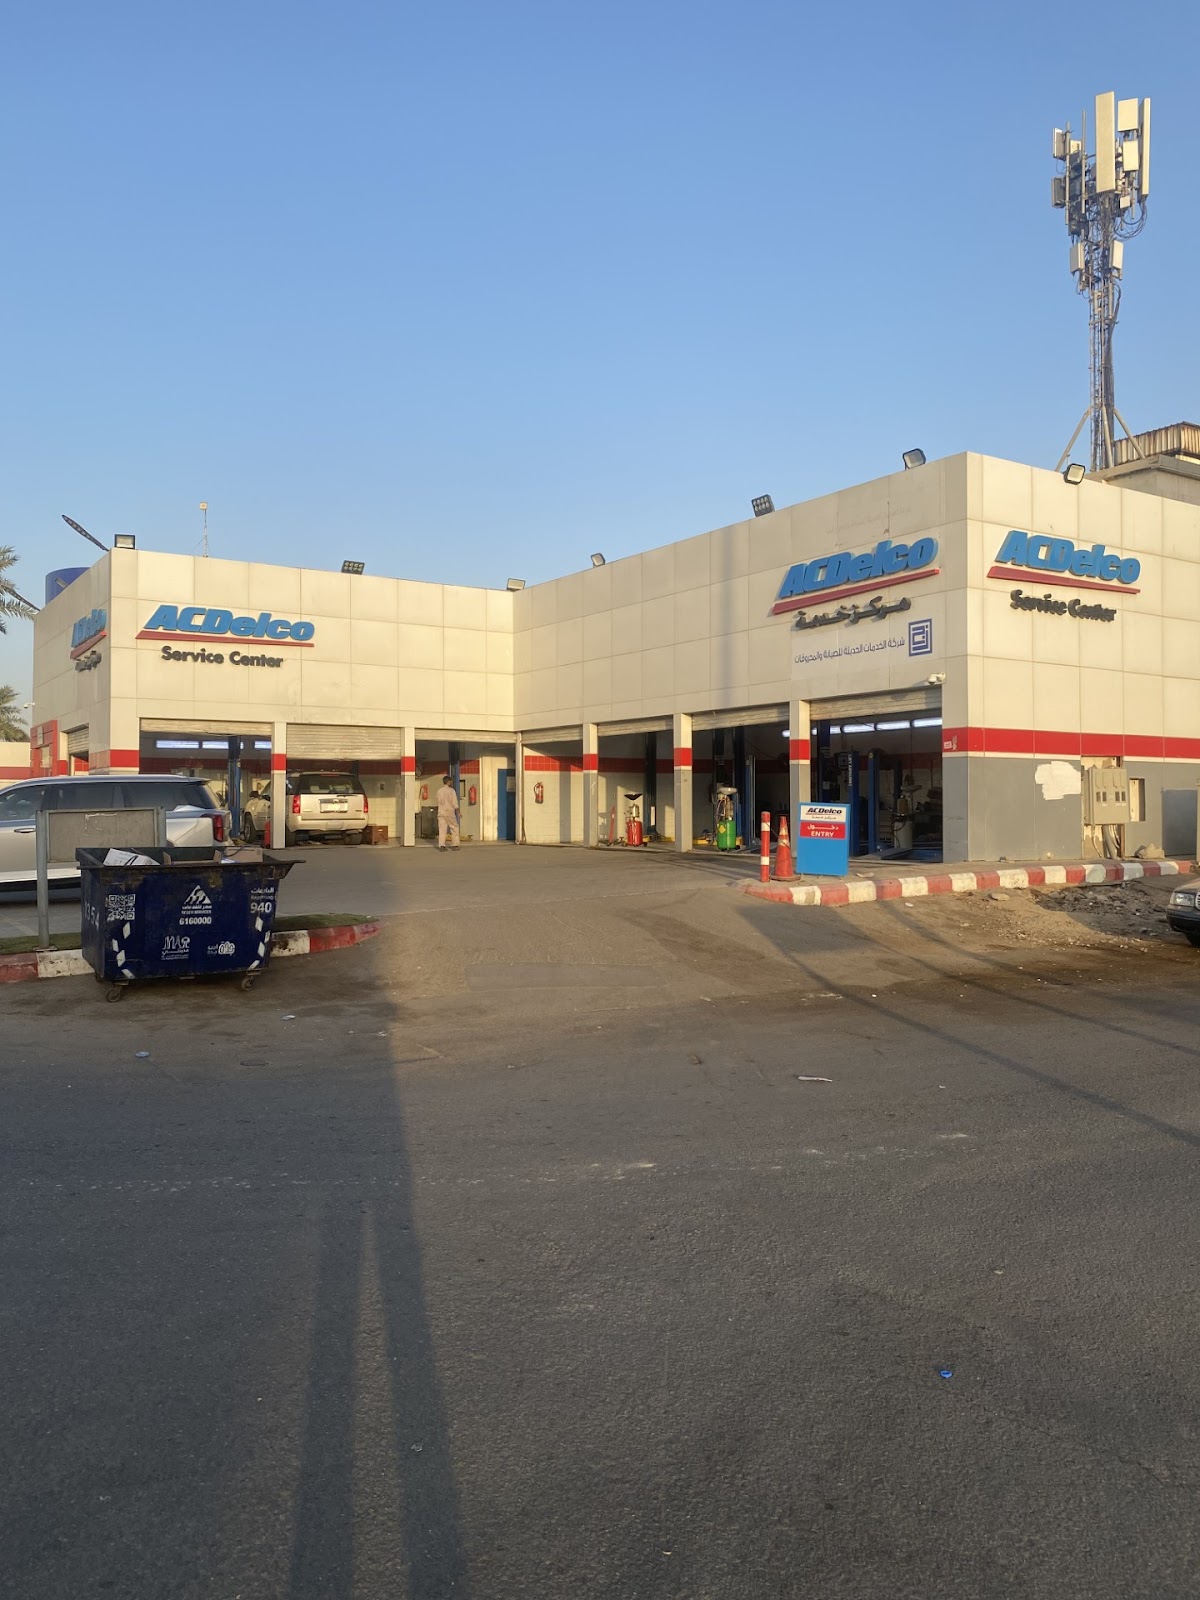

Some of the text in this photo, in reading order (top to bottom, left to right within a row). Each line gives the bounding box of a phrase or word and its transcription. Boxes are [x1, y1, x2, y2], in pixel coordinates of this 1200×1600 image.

[994, 530, 1141, 584] ACDelco
[777, 537, 939, 599] ACDelco
[1010, 589, 1117, 622] Service Center
[795, 596, 912, 631] مركز خدمة
[143, 604, 315, 641] ACDelco
[864, 640, 887, 652] الخدمات
[887, 636, 906, 648] شركة
[161, 645, 284, 668] Service Center
[807, 807, 842, 815] ACDelco
[807, 823, 839, 831] دخول
[811, 830, 834, 838] ENTRY
[250, 902, 272, 914] 940
[179, 916, 212, 926] 6160000
